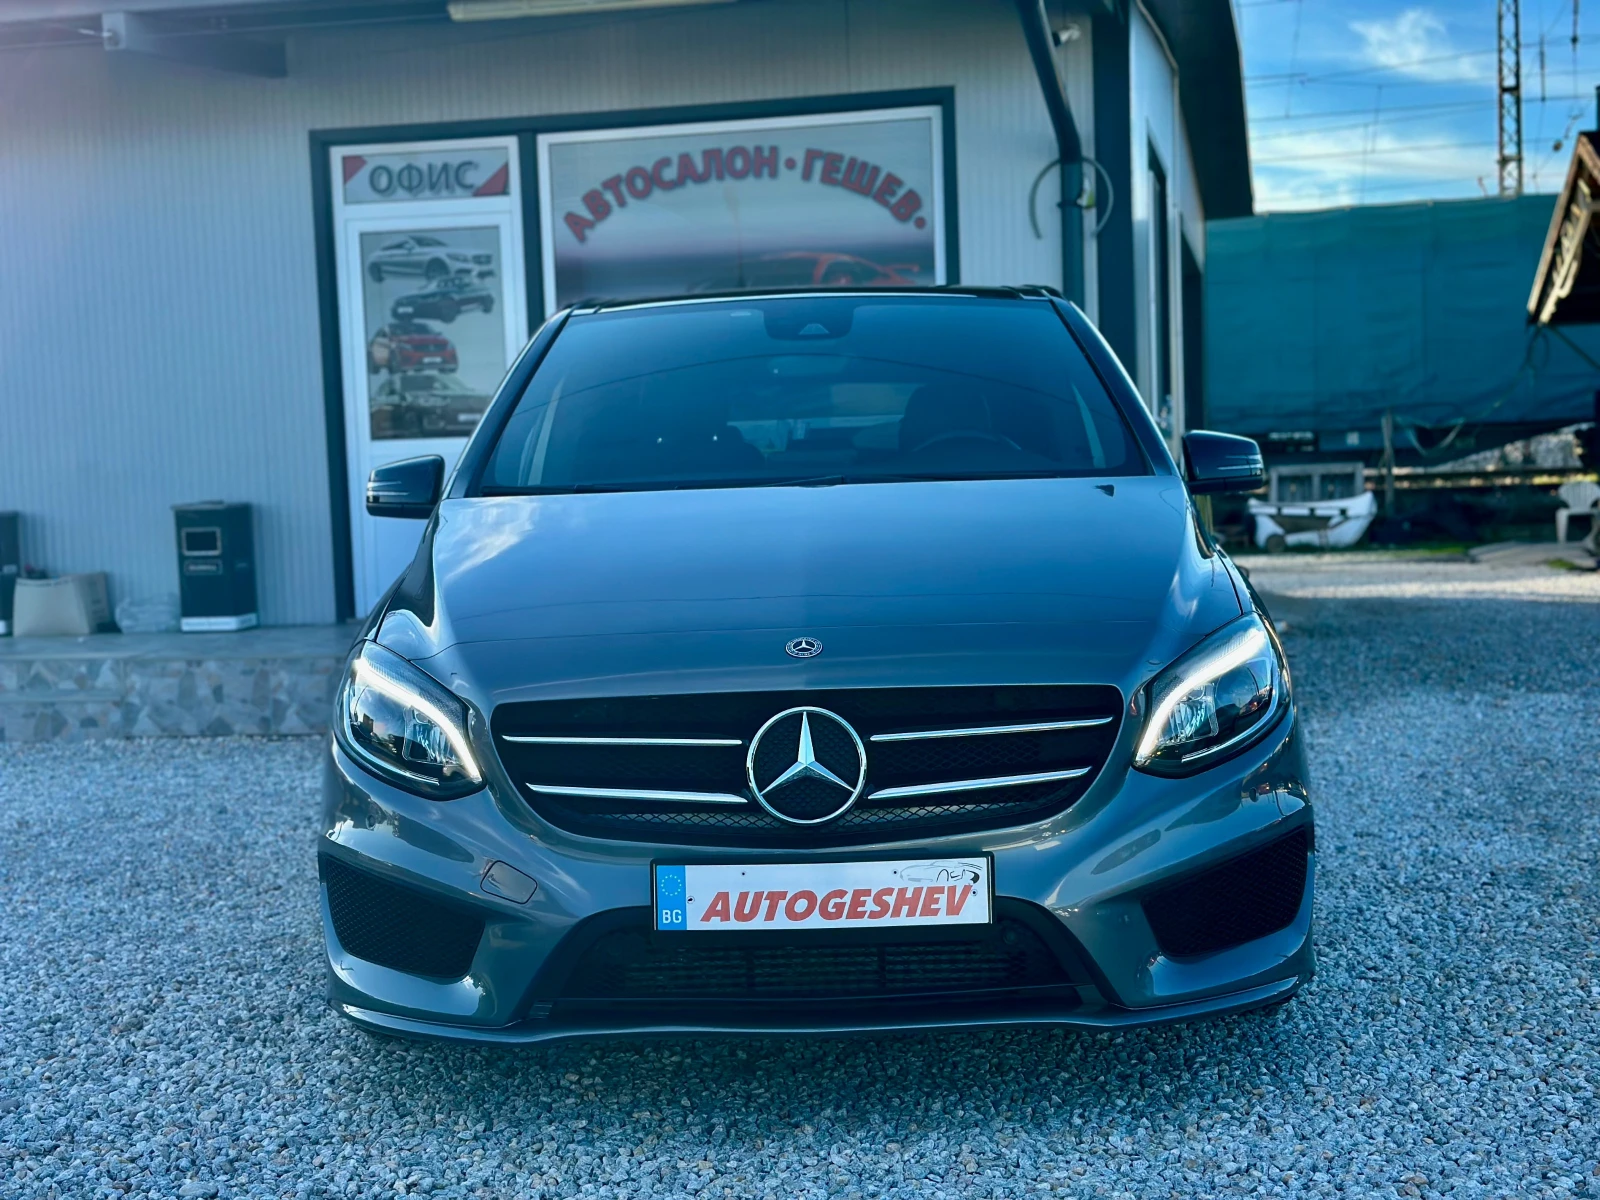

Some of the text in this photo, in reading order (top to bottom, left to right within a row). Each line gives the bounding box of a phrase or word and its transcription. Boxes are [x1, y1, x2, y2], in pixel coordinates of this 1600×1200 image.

[369, 160, 477, 197] ОФИС
[662, 909, 682, 924] BG
[700, 885, 972, 922] AUTOGESHEV
